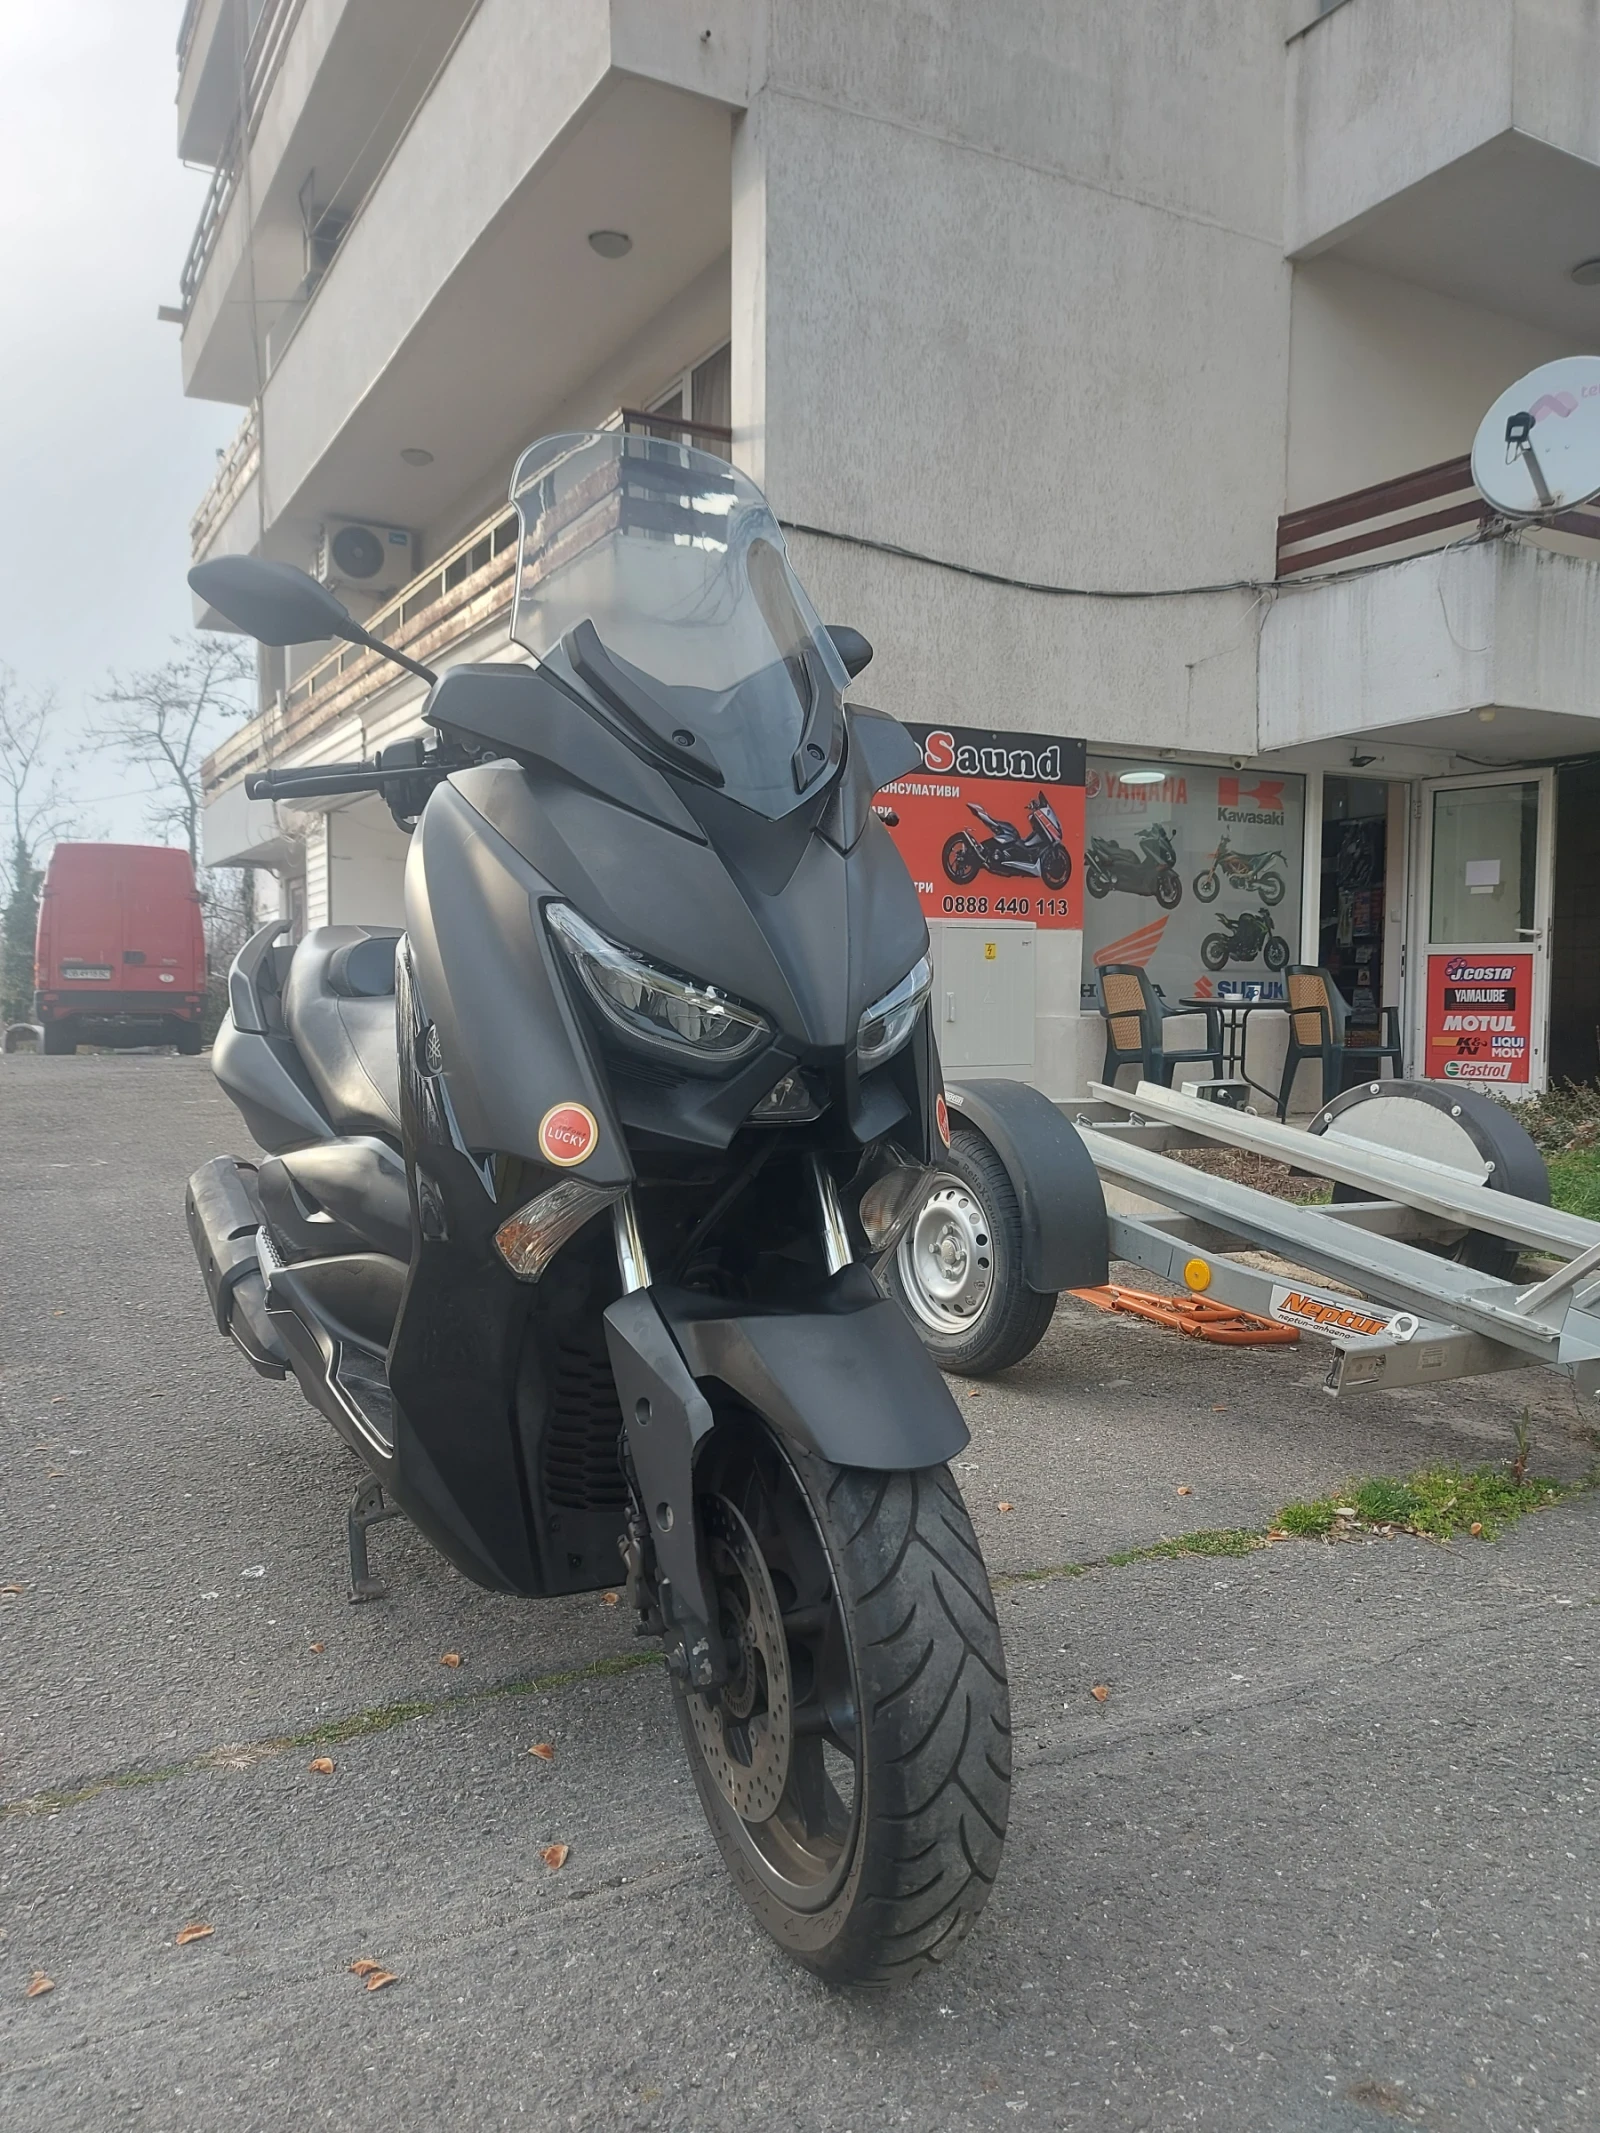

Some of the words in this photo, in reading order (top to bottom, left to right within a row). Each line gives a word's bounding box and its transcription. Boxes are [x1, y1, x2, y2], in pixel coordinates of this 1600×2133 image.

[915, 731, 1061, 781] Saund
[878, 783, 960, 798] ОНСУМАТИВИ
[1217, 807, 1284, 826] Kawasaki
[942, 895, 988, 915] 0888
[994, 897, 1030, 916] 440
[1036, 897, 1069, 917] 113
[1217, 980, 1284, 999] SUZUK
[1454, 988, 1506, 1003] YAMALUBE
[1442, 1015, 1516, 1032] MOTUL
[1491, 1036, 1525, 1048] LIQUI
[1491, 1047, 1525, 1058] MOLY
[1460, 1062, 1507, 1077] Castrol
[547, 1126, 586, 1148] LUCKY
